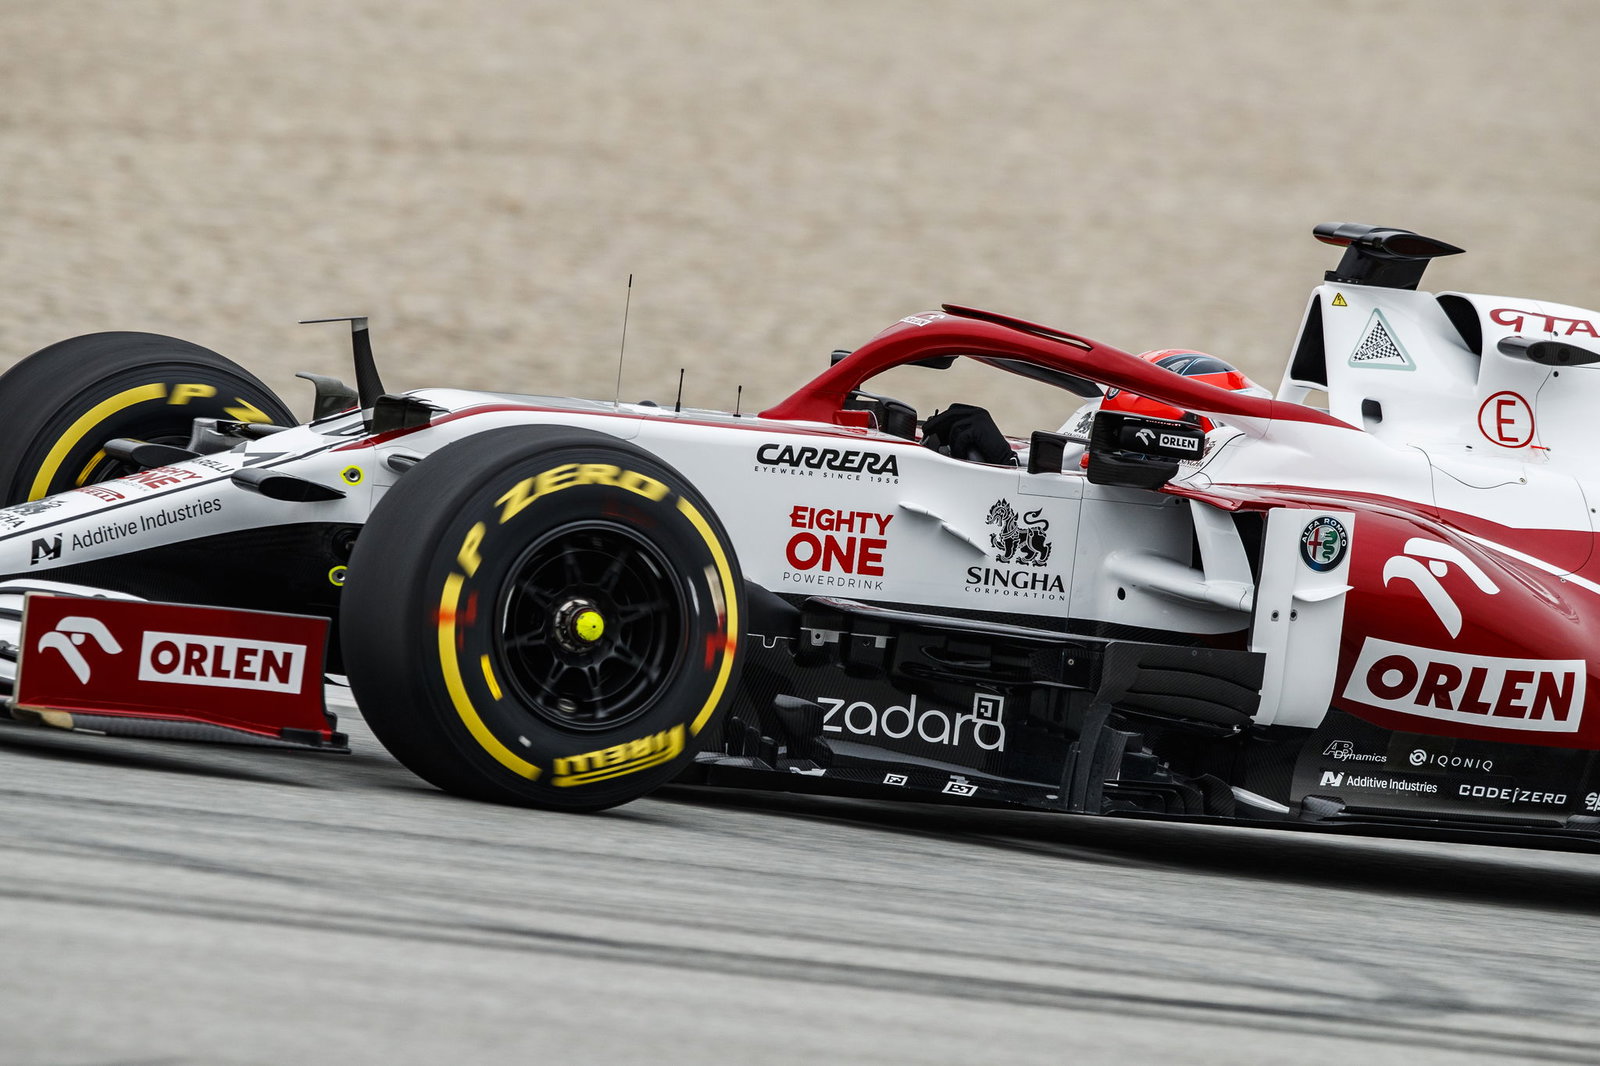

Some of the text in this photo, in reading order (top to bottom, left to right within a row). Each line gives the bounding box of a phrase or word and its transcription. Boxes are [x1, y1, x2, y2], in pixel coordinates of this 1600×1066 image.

[1496, 399, 1519, 443] E
[1161, 436, 1196, 449] ORLEN
[754, 465, 900, 485] EYEWEAR SINCE 1956
[756, 443, 899, 477] CARRERA
[72, 518, 138, 551] Additive
[140, 496, 223, 532] Industries
[457, 463, 671, 579] P ZERO
[789, 505, 895, 536] EIGHTY
[1301, 517, 1348, 548] ALFA ROMEO
[785, 531, 888, 577] ONE
[782, 571, 884, 591] POWERDRINK
[964, 585, 1065, 601] CORPORATION
[965, 566, 1065, 594] SINGHA
[150, 640, 294, 685] ORLEN
[1365, 654, 1577, 722] ORLEN
[817, 693, 1006, 752] zadara
[1333, 750, 1388, 763] Dynamics
[1430, 754, 1493, 772] IQONIQ
[1346, 775, 1388, 789] Additive
[1389, 778, 1438, 794] Industries
